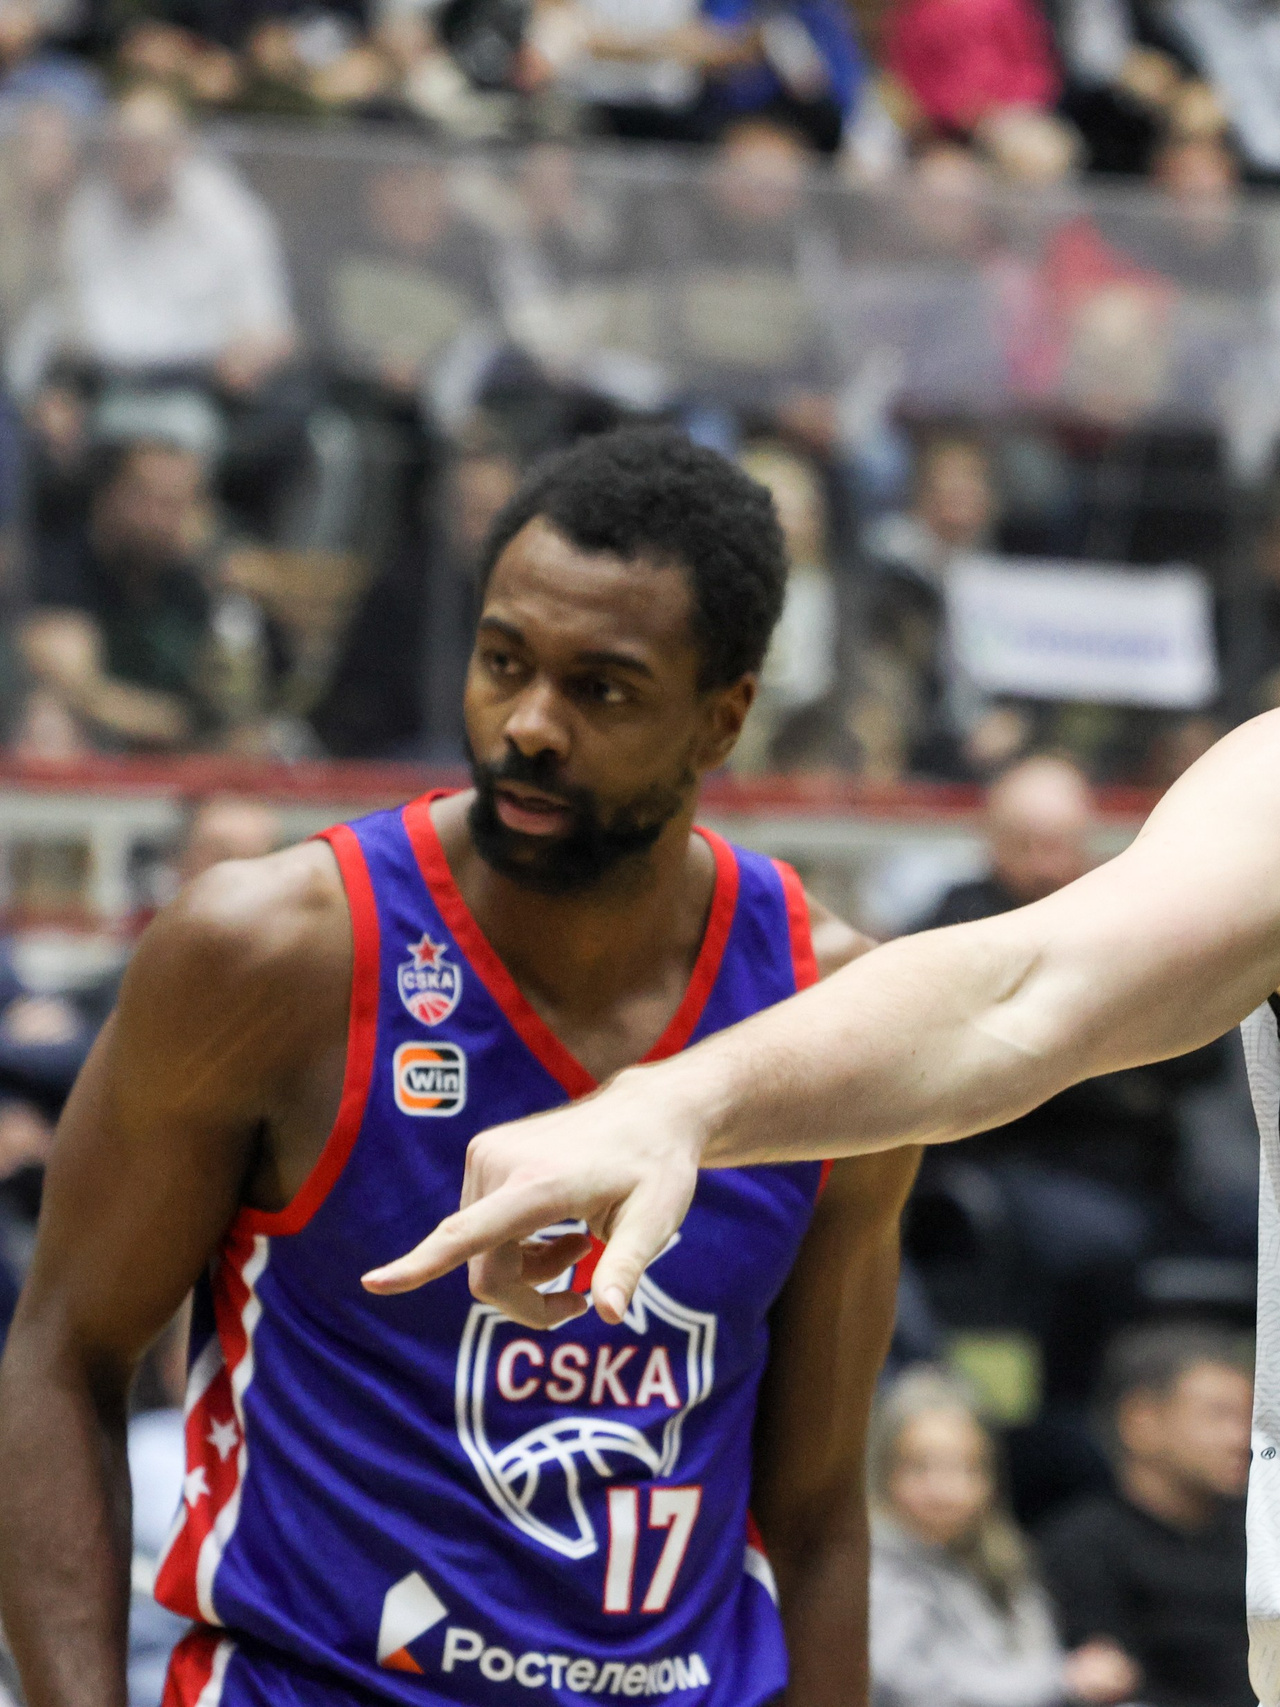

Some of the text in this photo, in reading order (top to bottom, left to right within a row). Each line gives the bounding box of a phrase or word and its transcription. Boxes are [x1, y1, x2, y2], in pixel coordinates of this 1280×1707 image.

[402, 971, 454, 990] CSKA
[408, 1067, 459, 1092] Win
[497, 1338, 681, 1408] CSKA
[603, 1485, 702, 1615] 17
